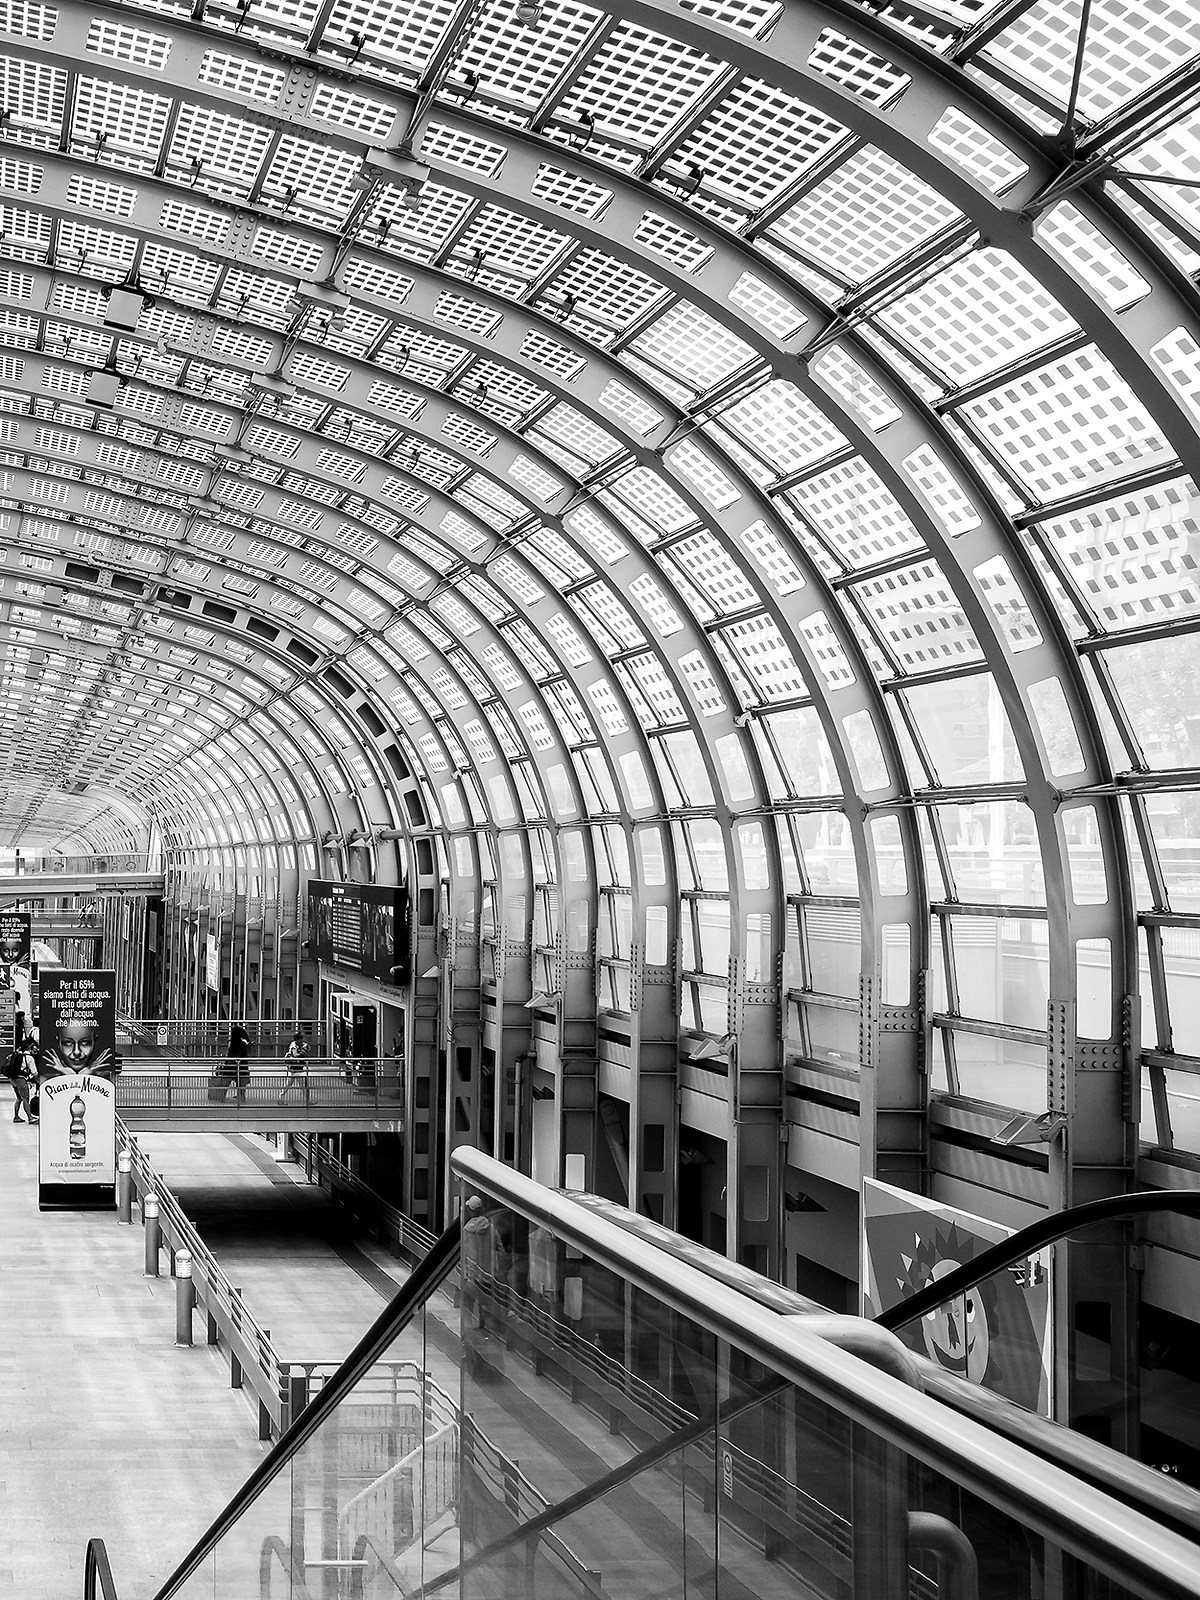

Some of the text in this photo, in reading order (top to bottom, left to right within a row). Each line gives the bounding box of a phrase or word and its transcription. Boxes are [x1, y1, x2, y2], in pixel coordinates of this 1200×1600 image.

[60, 980, 95, 989] Per il 65%
[43, 990, 111, 1000] siamo fatti di acqua.
[58, 1000, 74, 1008] resto
[76, 999, 103, 1009] dipende
[60, 1009, 94, 1019] dall'acqua
[56, 1018, 99, 1027] che beviamo.
[45, 1084, 69, 1100] Pian
